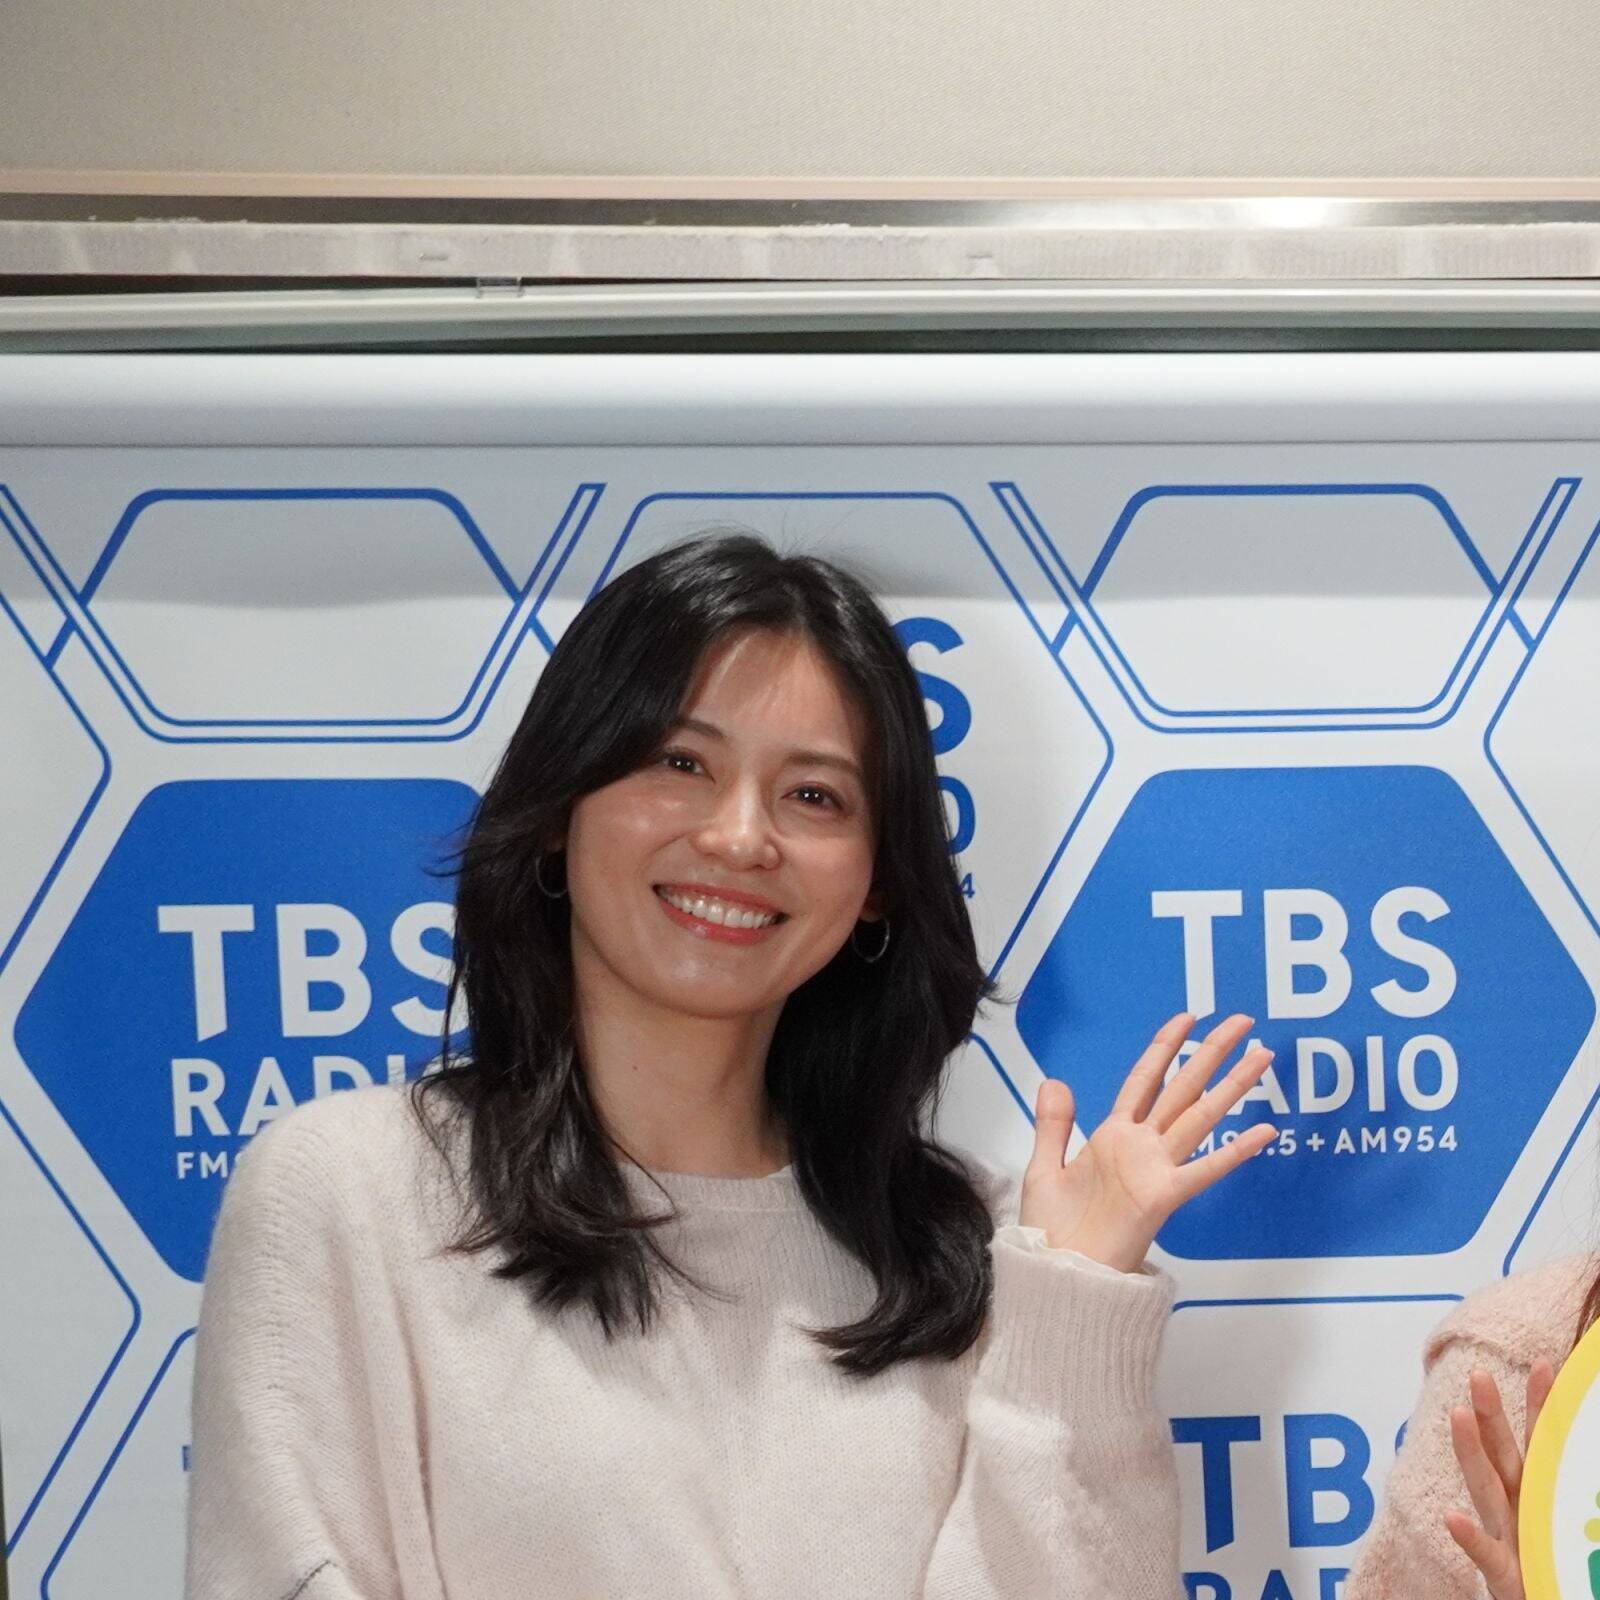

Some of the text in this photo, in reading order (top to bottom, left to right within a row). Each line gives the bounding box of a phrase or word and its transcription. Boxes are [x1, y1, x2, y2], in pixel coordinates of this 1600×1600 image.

[158, 901, 469, 1042] TBS
[1151, 886, 1458, 1023] TBS
[1170, 1413, 1410, 1553] TB
